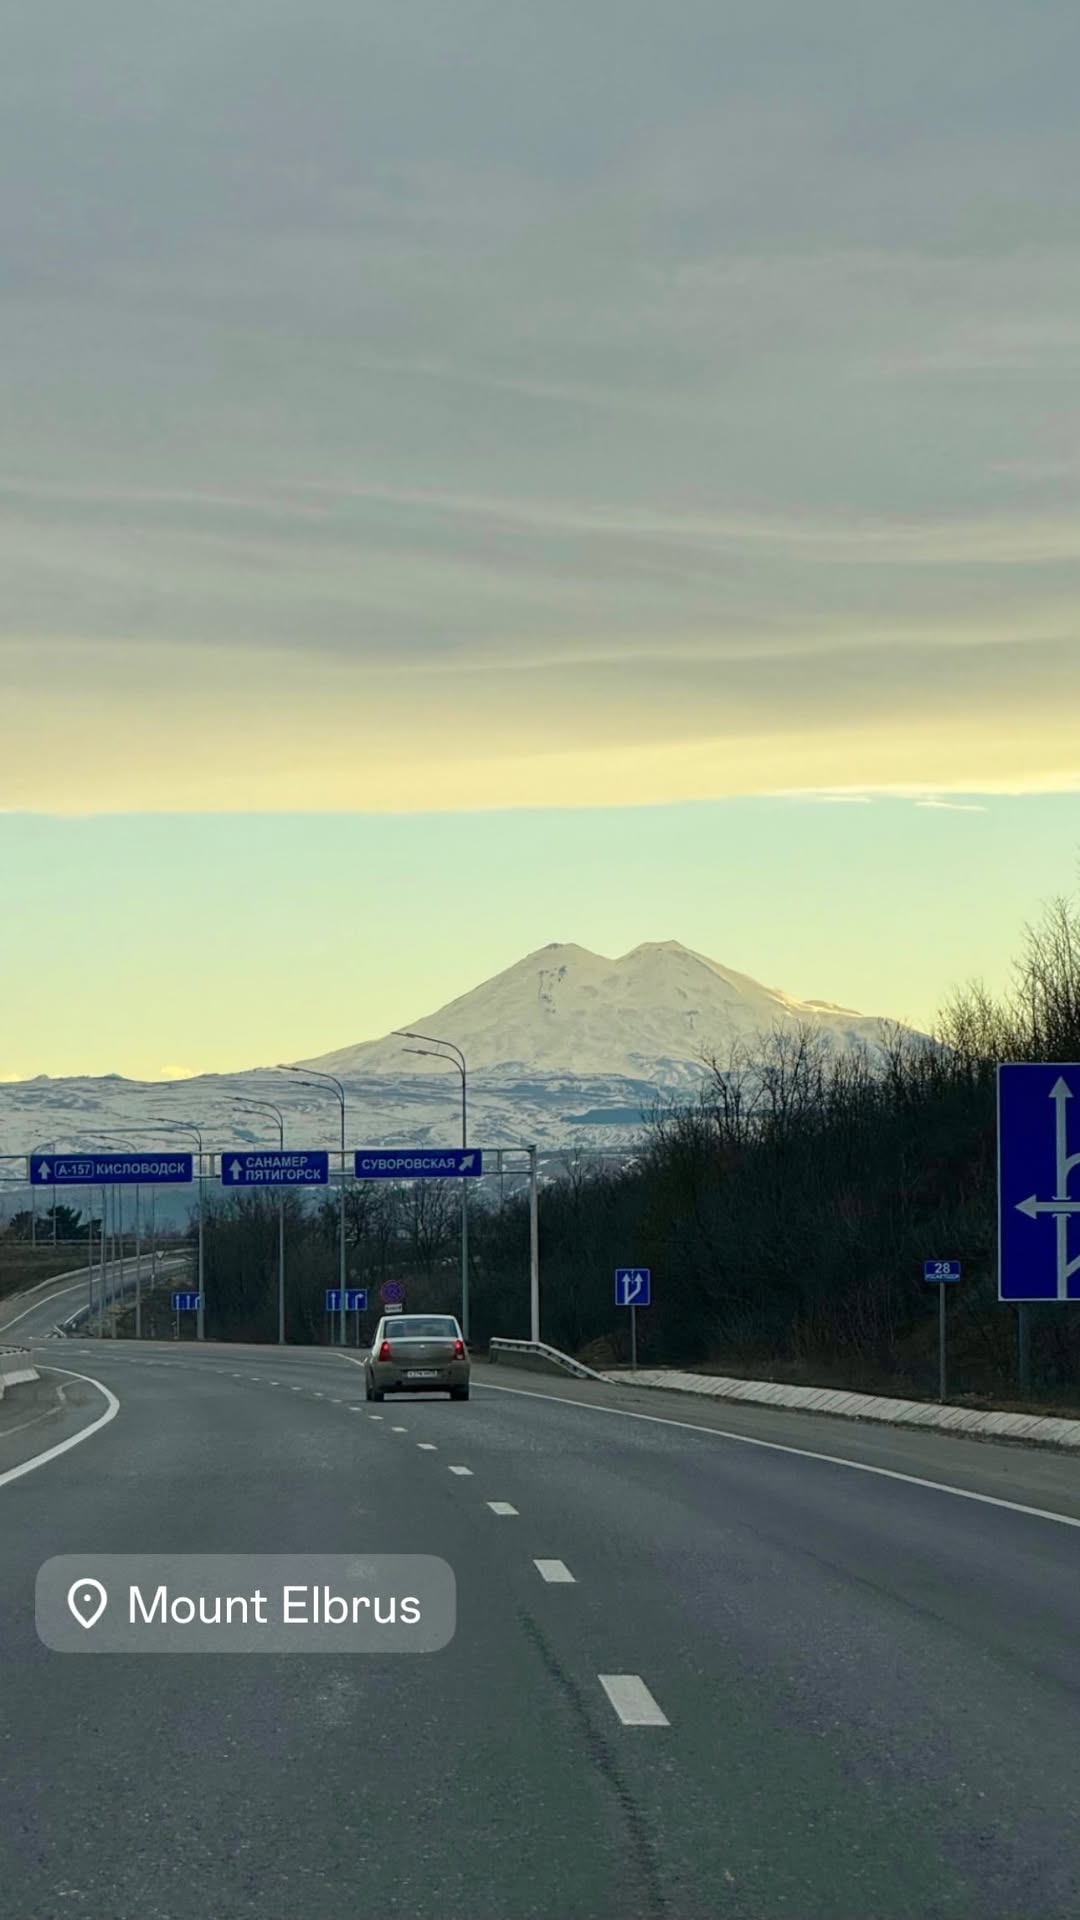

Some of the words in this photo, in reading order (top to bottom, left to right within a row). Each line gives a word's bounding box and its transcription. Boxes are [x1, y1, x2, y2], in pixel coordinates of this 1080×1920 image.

[96, 1161, 185, 1175] КИСЛОВОДСК
[246, 1157, 308, 1169] САНАМЕР
[361, 1158, 455, 1170] СУВОРОВСКАЯ
[245, 1169, 321, 1182] ПЯТИГОРСК
[934, 1262, 951, 1274] 28
